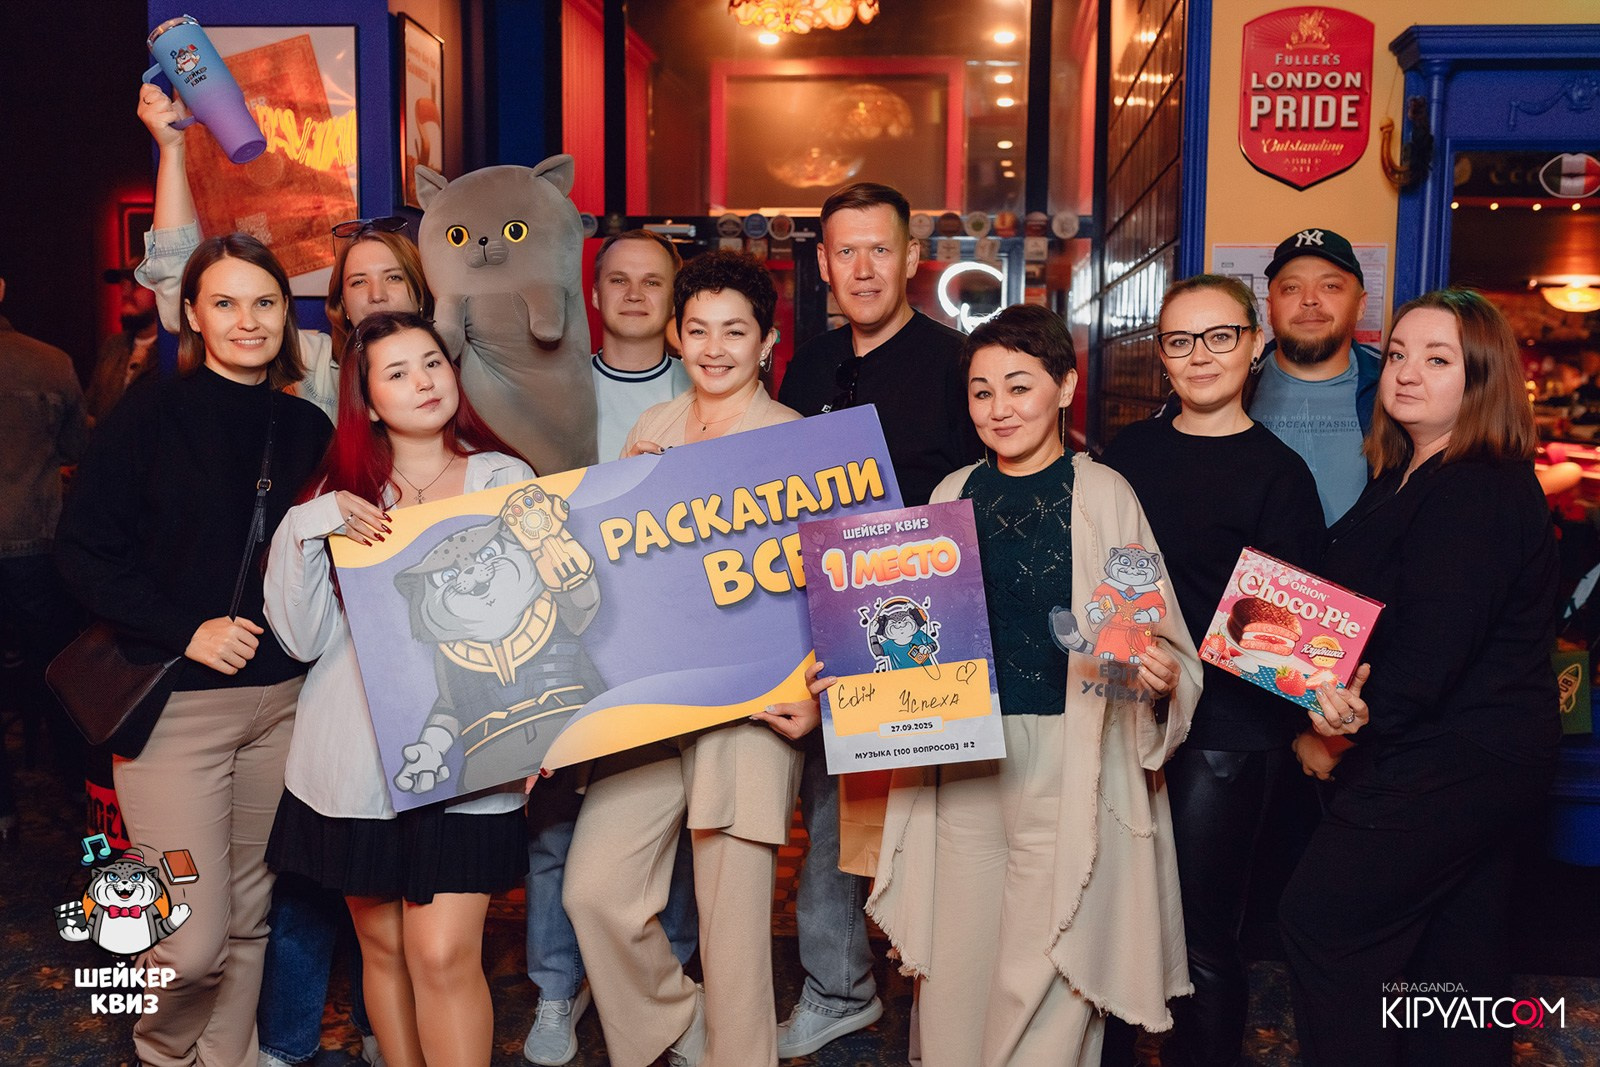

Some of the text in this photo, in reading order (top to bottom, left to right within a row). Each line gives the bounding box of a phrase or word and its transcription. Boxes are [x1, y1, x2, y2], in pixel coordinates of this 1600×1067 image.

[1275, 53, 1341, 65] FULLER'S
[1251, 71, 1362, 89] LONDON
[1250, 94, 1360, 130] PRIDE
[1261, 138, 1345, 155] Outstanding
[1295, 229, 1325, 248] NY
[1278, 420, 1314, 428] OCEAN
[600, 457, 885, 562] РАСКАТАЛИ
[843, 517, 930, 540] ШЕЙКЕР КВИЗ
[823, 539, 959, 590] 1 МЕСТО
[1290, 580, 1328, 602] ORION
[890, 721, 934, 733] 27.09.2025
[854, 750, 892, 760] МУЗЫКА
[893, 747, 911, 757] [100
[912, 743, 960, 755] ВОПРОСОВ]
